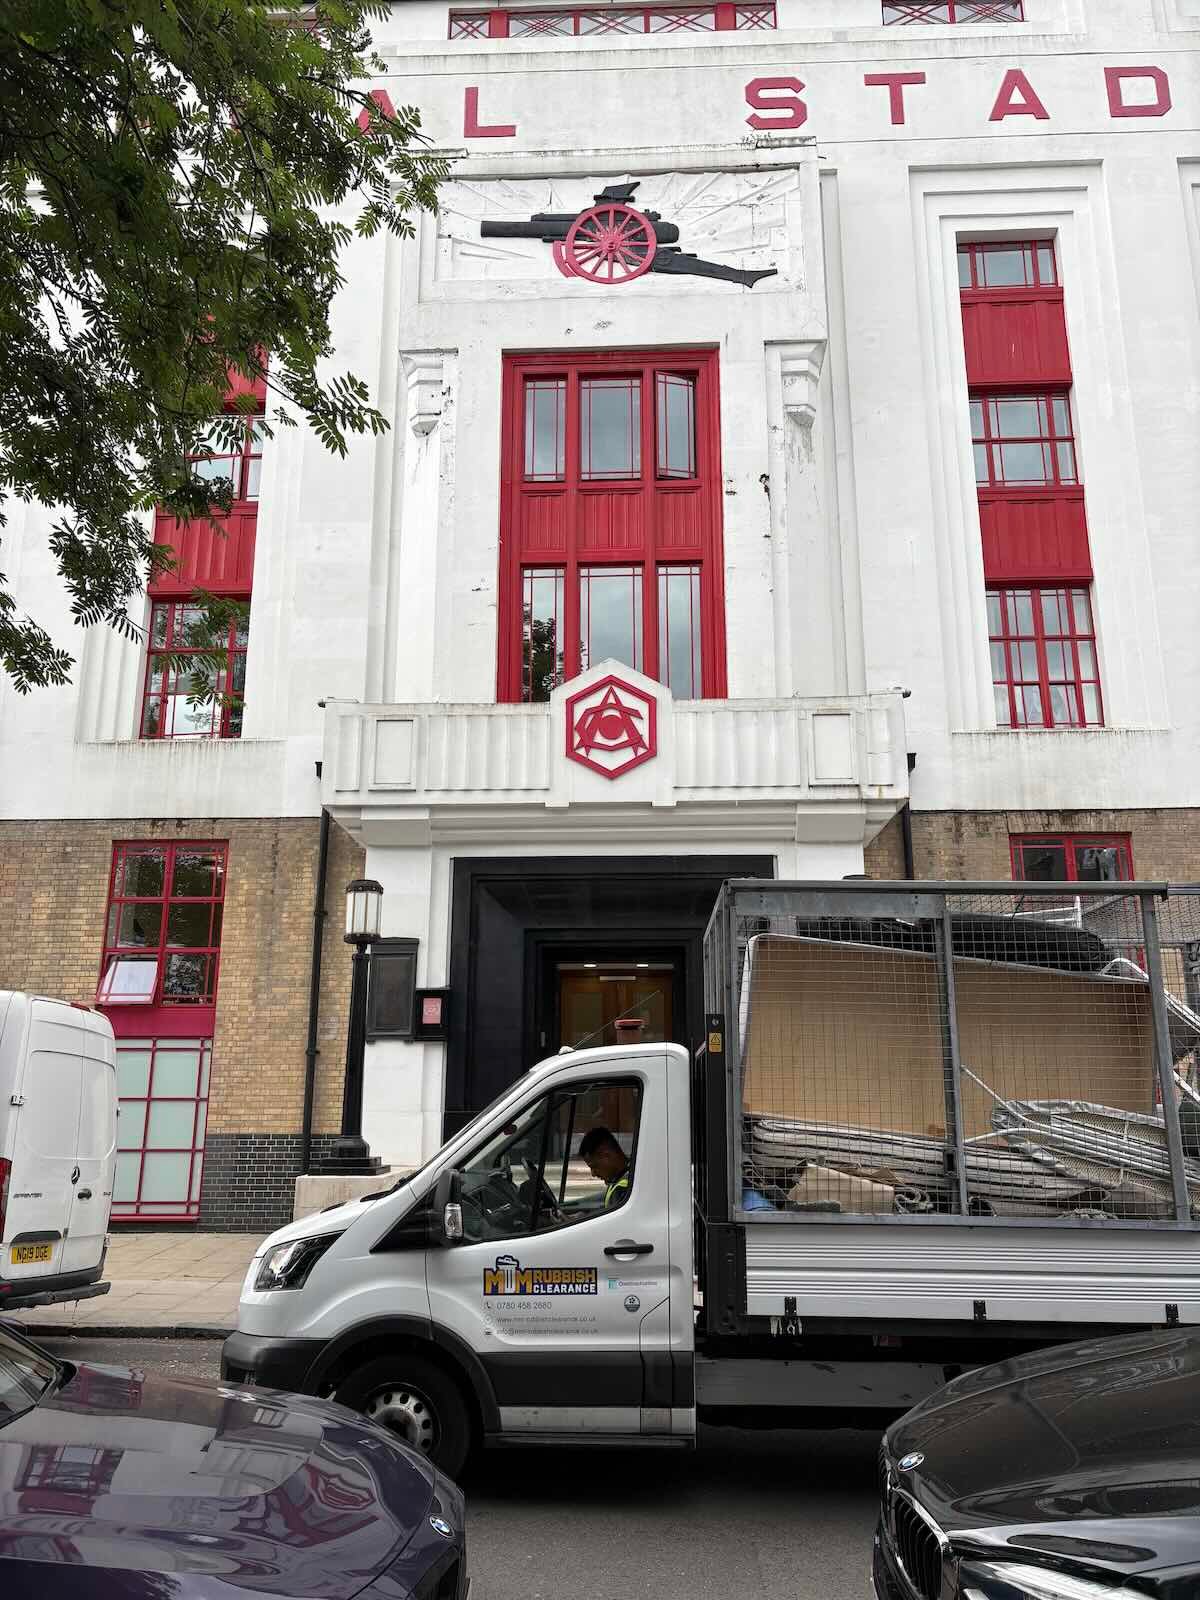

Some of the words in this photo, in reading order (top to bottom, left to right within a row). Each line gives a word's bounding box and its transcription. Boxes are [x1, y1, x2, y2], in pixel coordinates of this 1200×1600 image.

[744, 65, 1173, 130] STAD
[533, 1269, 596, 1283] RUBBISH
[533, 1283, 596, 1294] CLEARANCE
